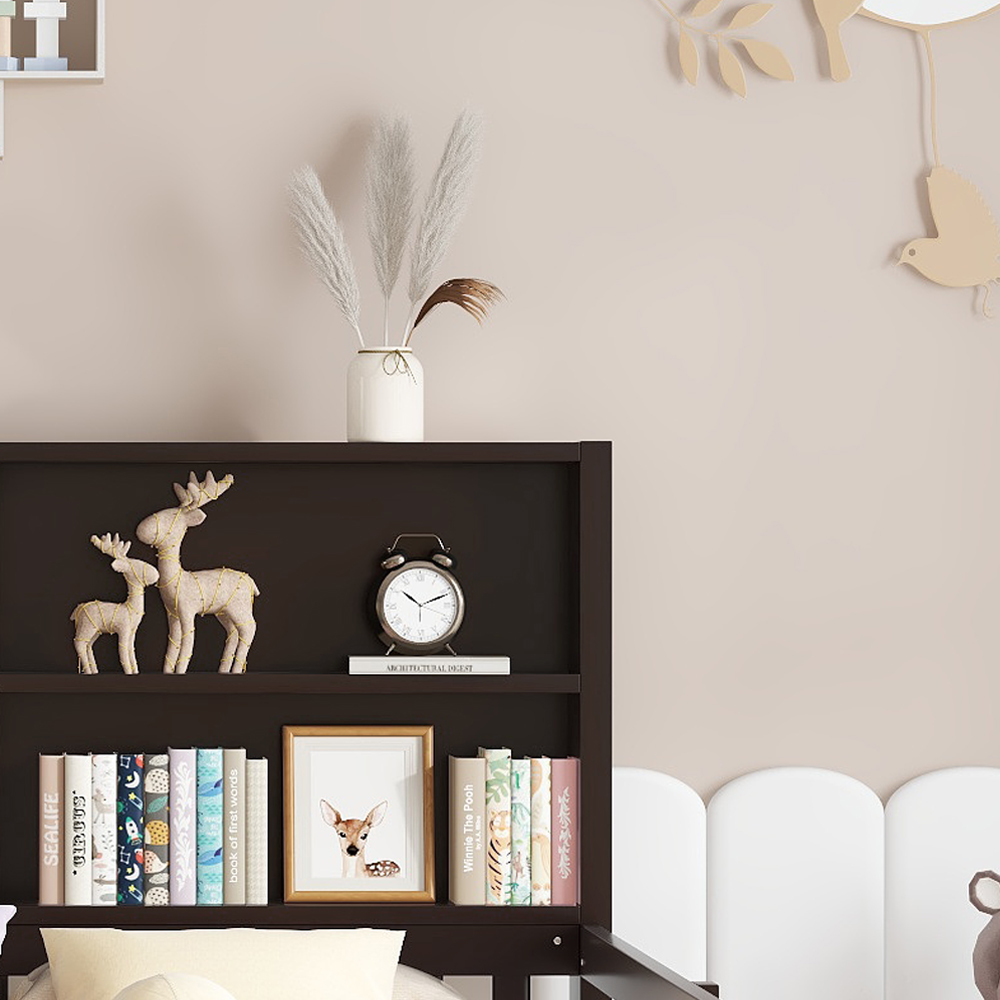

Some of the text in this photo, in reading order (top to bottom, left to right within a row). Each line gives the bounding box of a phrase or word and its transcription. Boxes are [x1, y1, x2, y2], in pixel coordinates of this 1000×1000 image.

[386, 664, 473, 672] ARCHITECTURAL DIGEST
[44, 792, 59, 866] SEALIFE
[229, 769, 238, 883] book of first words
[463, 784, 474, 873] Winnie The Pooh
